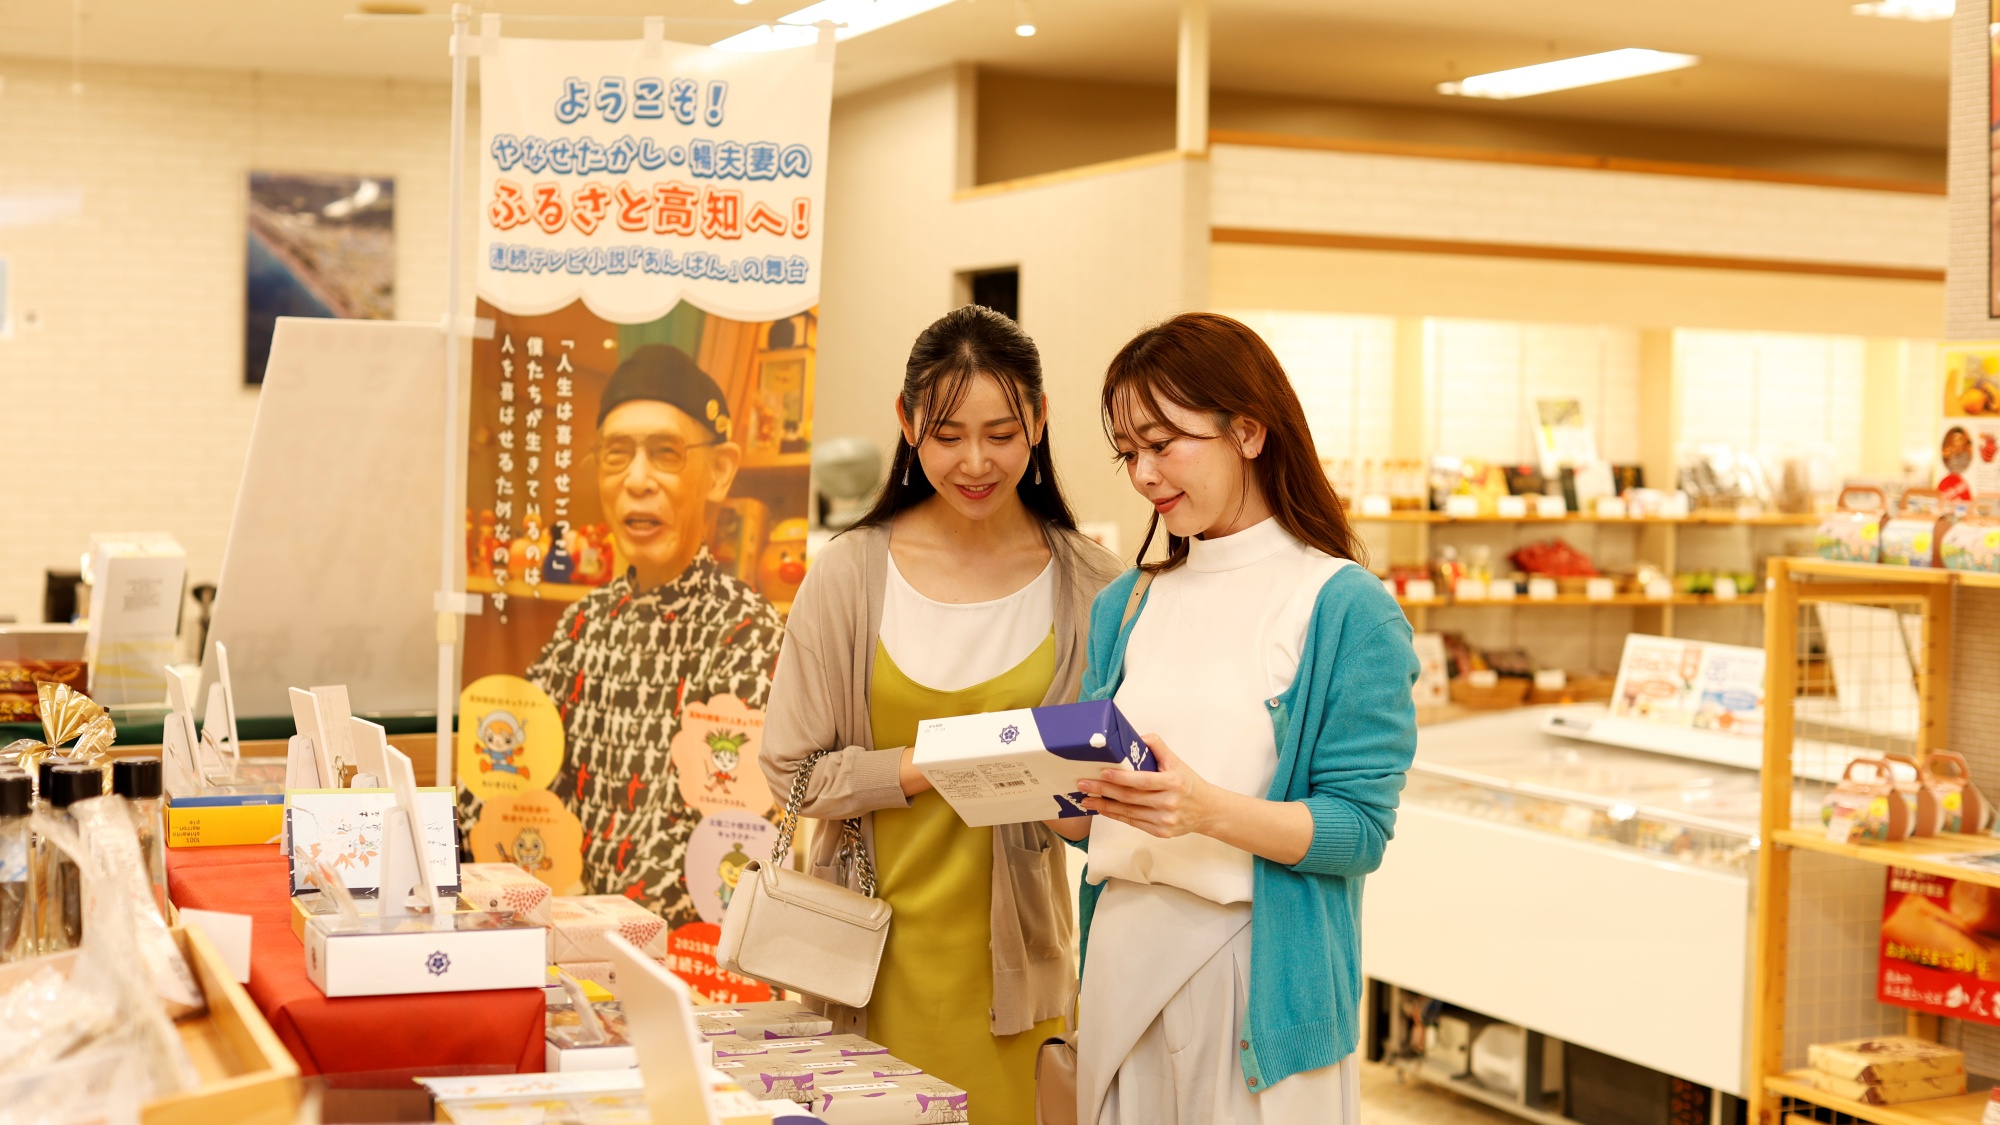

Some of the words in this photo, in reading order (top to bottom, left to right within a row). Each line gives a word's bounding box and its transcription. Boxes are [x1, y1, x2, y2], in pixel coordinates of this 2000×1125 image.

[556, 76, 729, 126] ようこそ！
[491, 134, 812, 181] やなせたかし・暢夫妻の
[488, 179, 811, 241] ふるさと高知へ！
